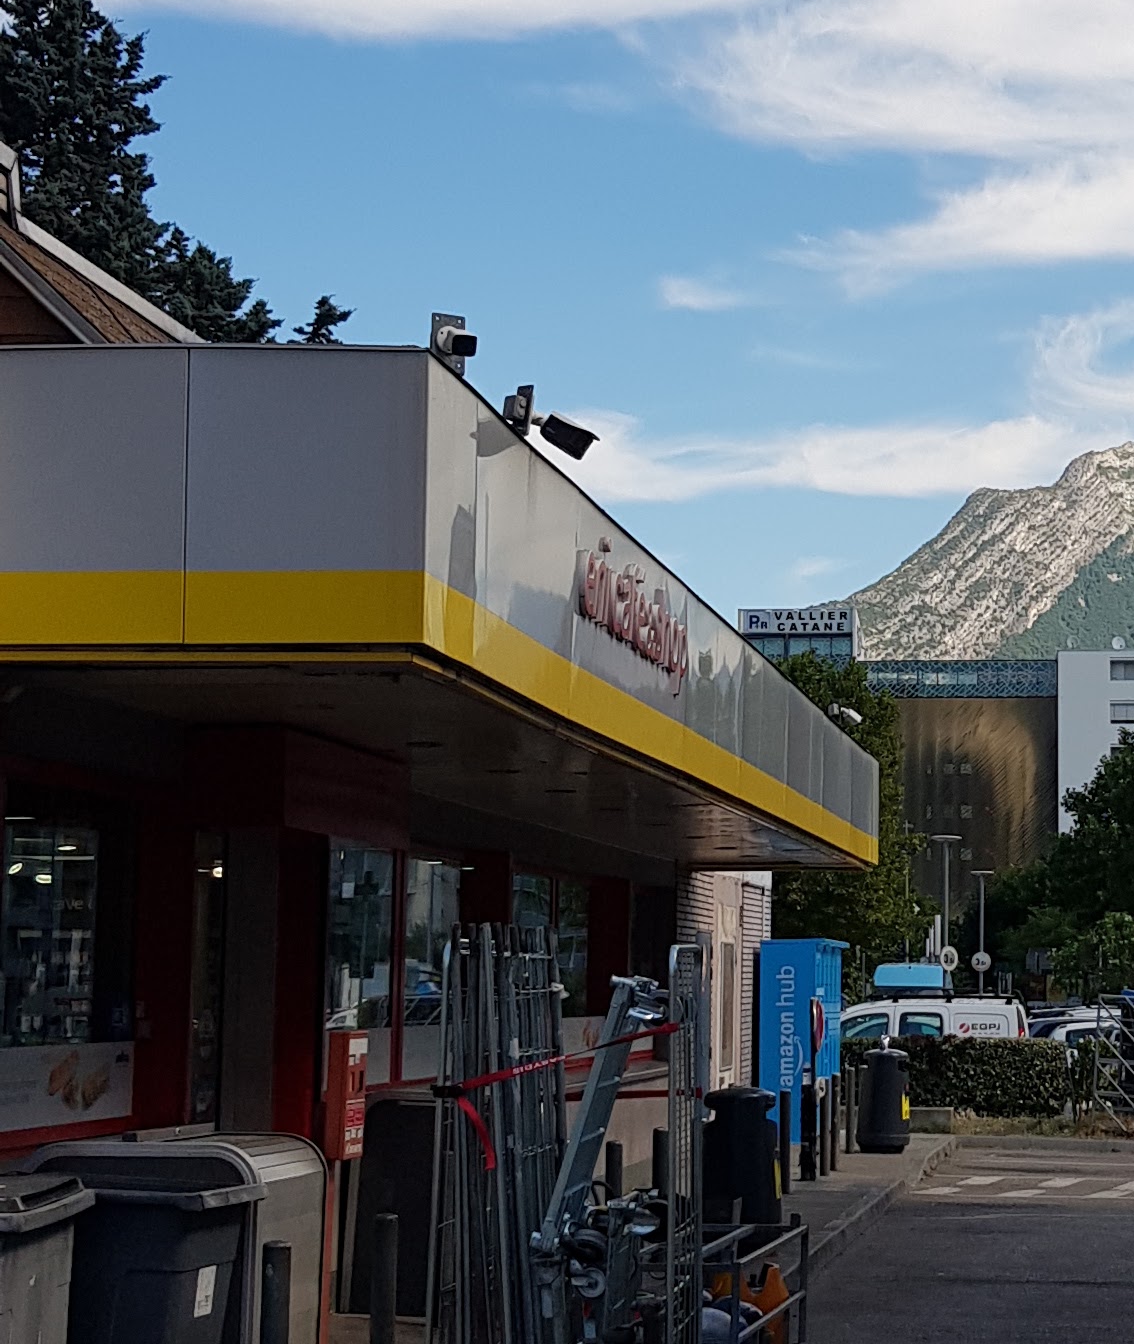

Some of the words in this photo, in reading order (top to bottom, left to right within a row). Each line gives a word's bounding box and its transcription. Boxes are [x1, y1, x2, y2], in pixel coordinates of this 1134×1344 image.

[774, 611, 848, 621] VALLIER
[777, 622, 845, 632] CATANE
[775, 965, 795, 1006] hub
[780, 1011, 795, 1088] amazon
